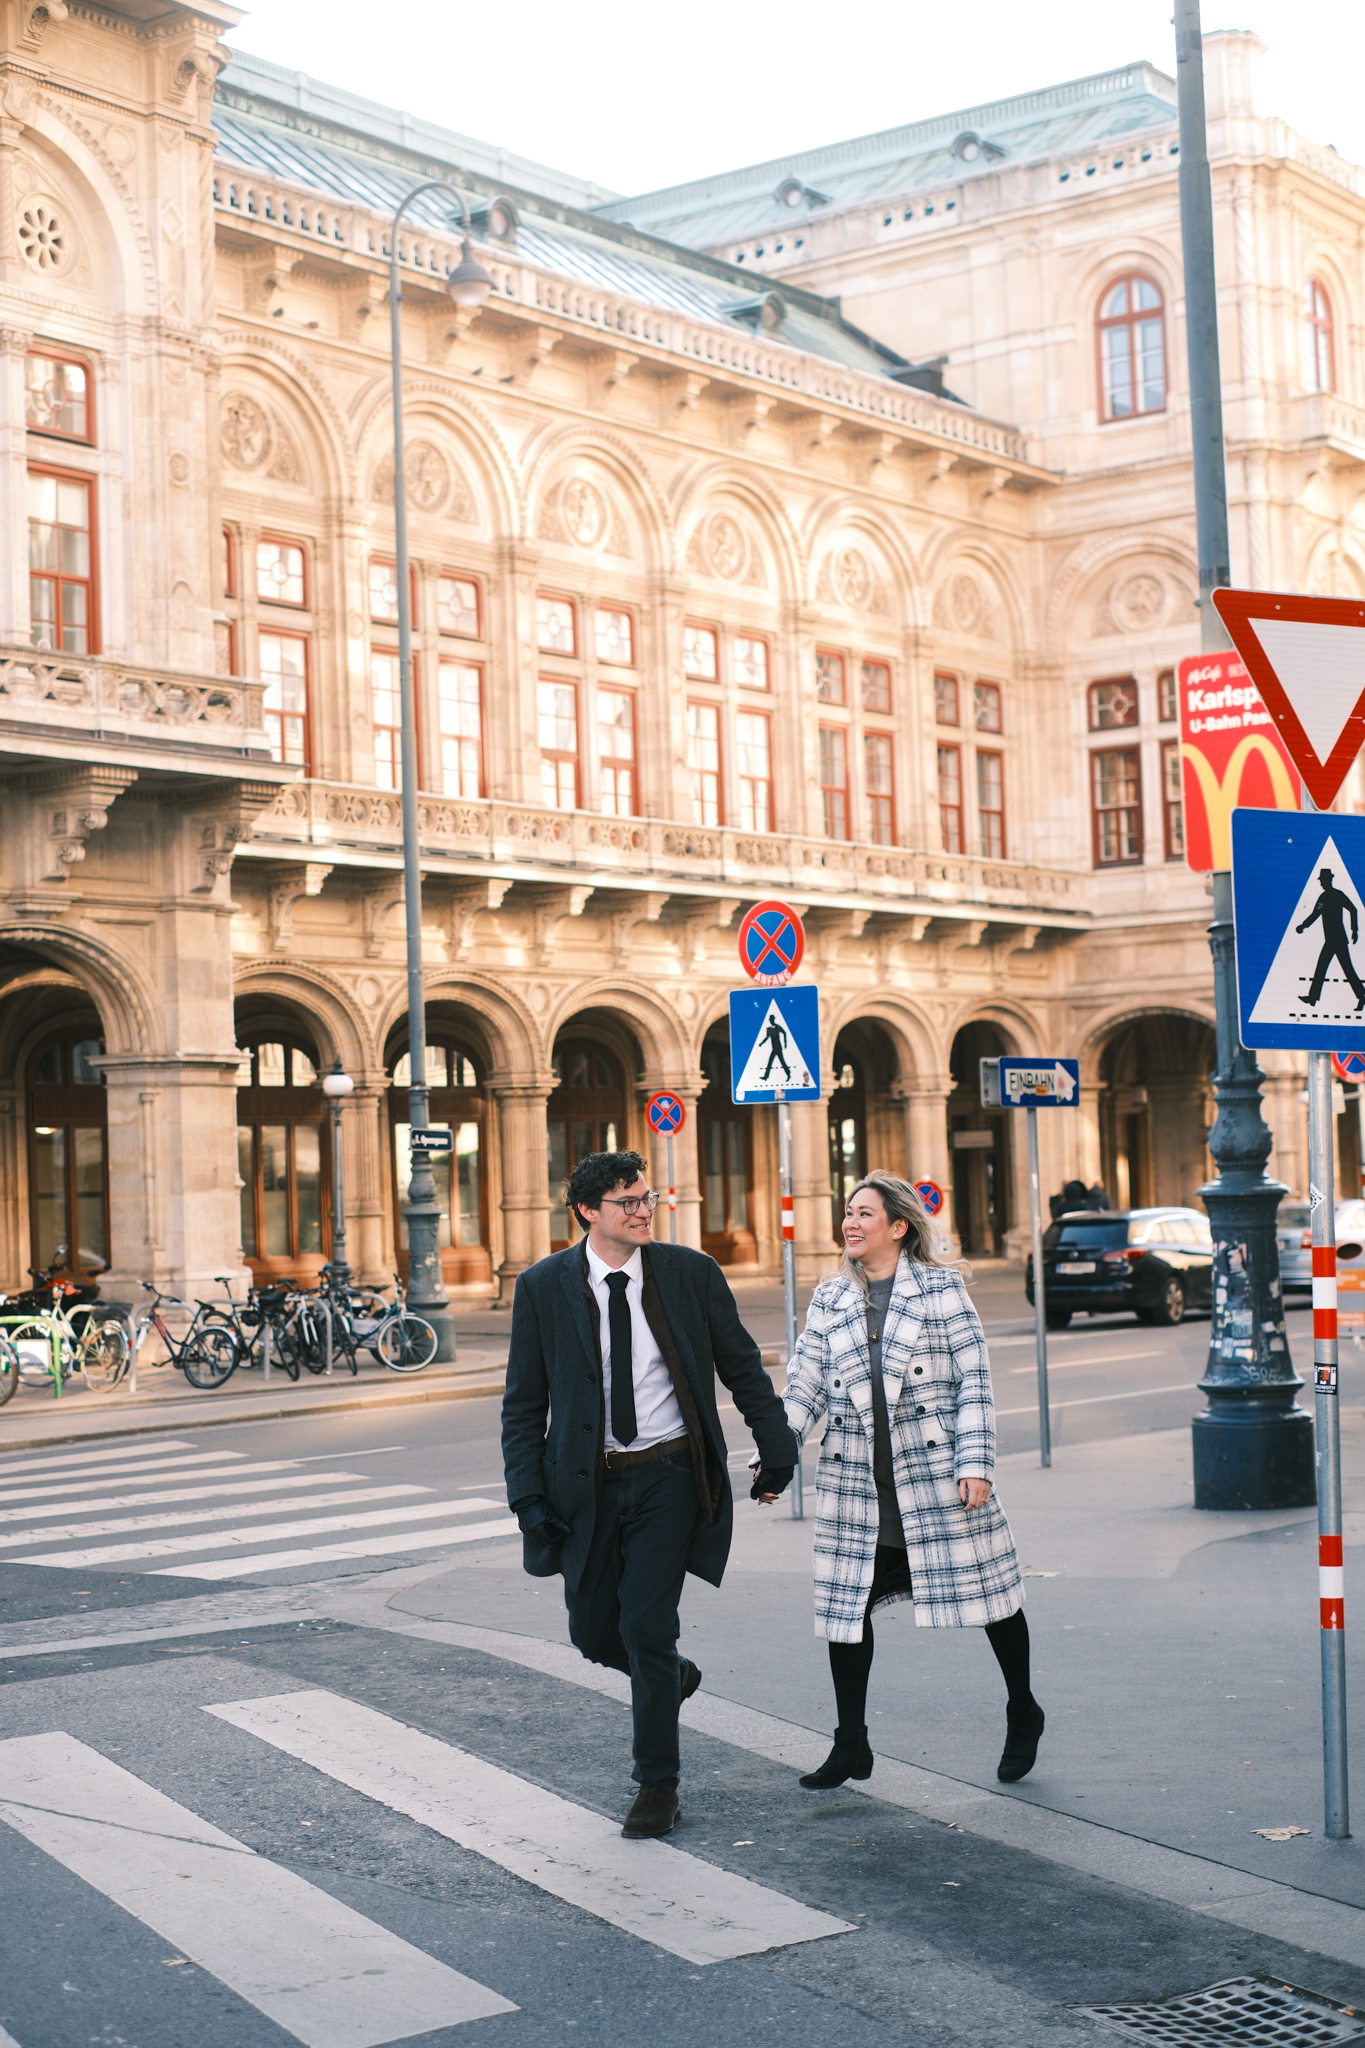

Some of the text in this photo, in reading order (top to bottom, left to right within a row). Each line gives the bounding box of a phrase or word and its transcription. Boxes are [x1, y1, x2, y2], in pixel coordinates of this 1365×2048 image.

[1188, 684, 1263, 713] Karlsp
[1189, 714, 1242, 734] U-Bahn
[754, 969, 792, 986] ANFANG
